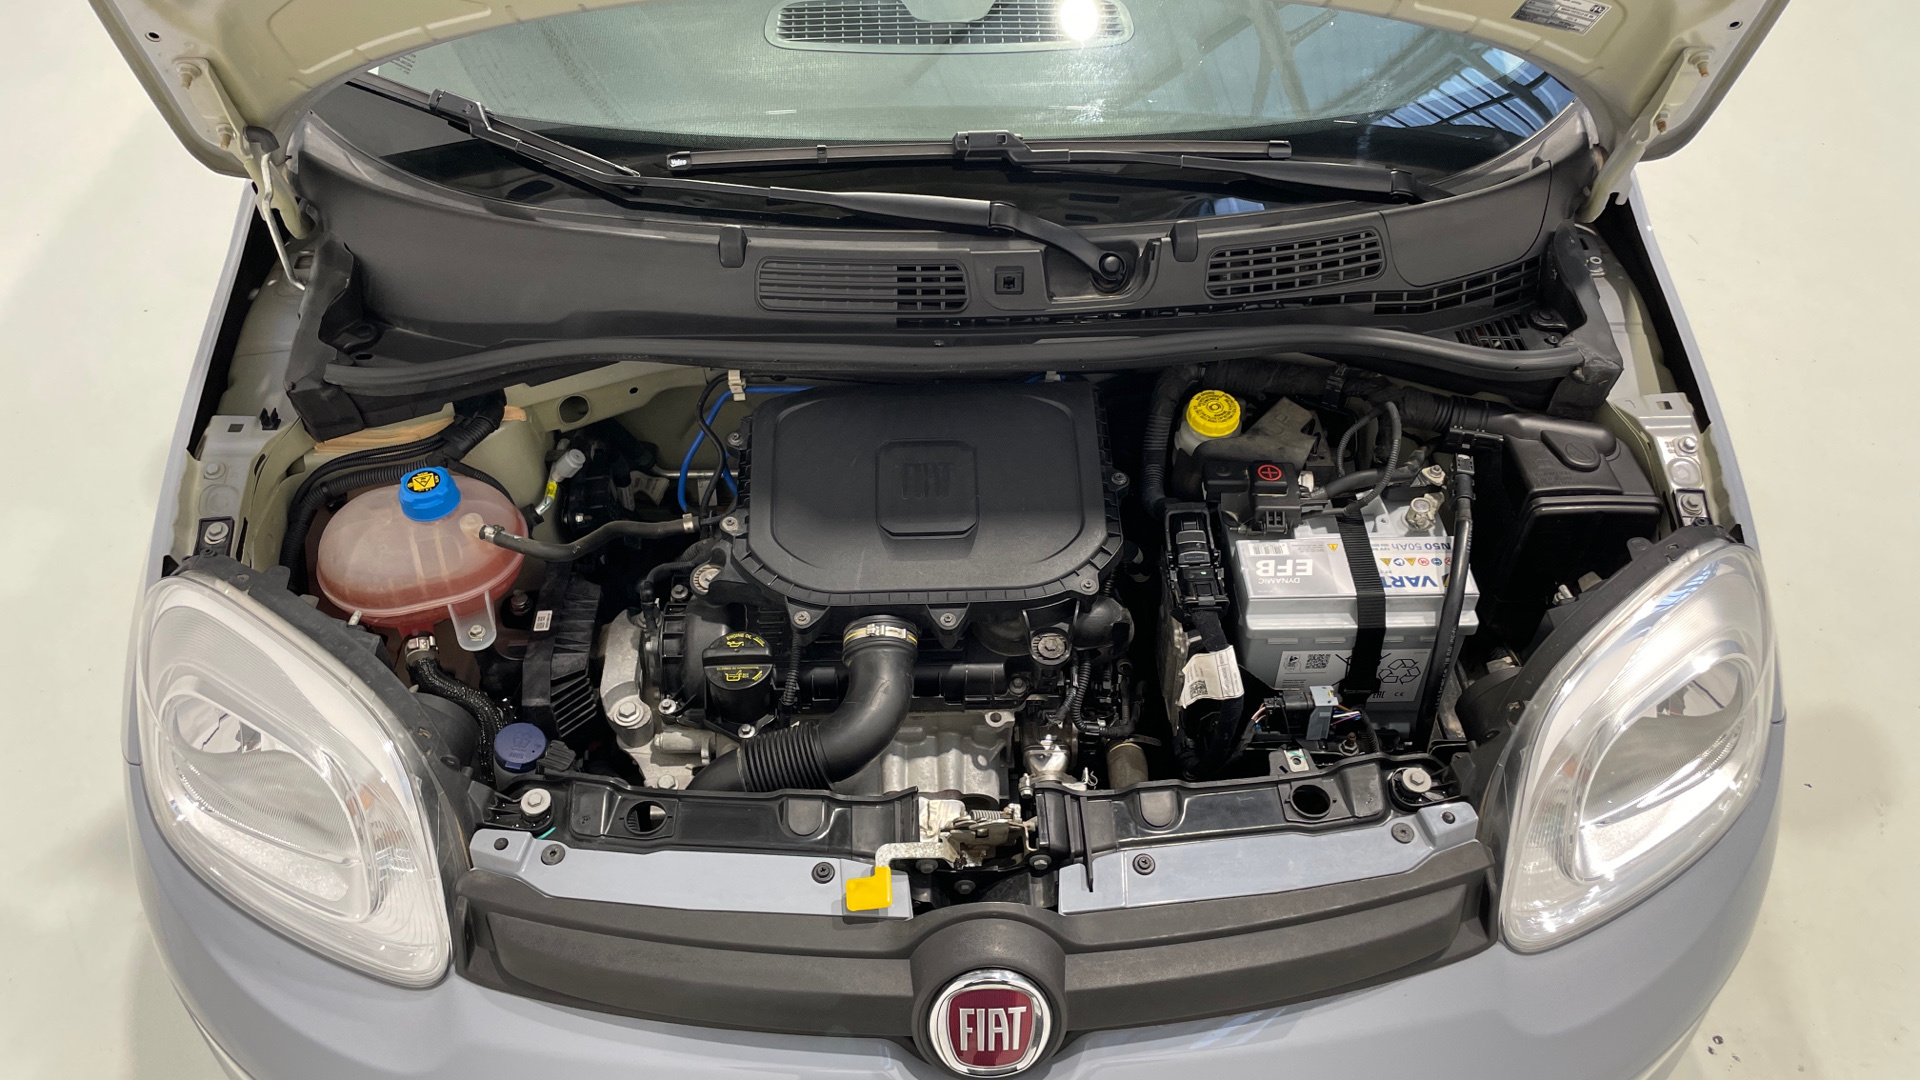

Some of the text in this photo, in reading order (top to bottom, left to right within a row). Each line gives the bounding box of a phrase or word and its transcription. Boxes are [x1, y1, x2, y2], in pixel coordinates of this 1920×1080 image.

[1391, 542, 1422, 550] 50Ah
[1424, 542, 1451, 551] N50
[1255, 559, 1313, 577] EFB
[959, 1006, 1027, 1052] FIAT
